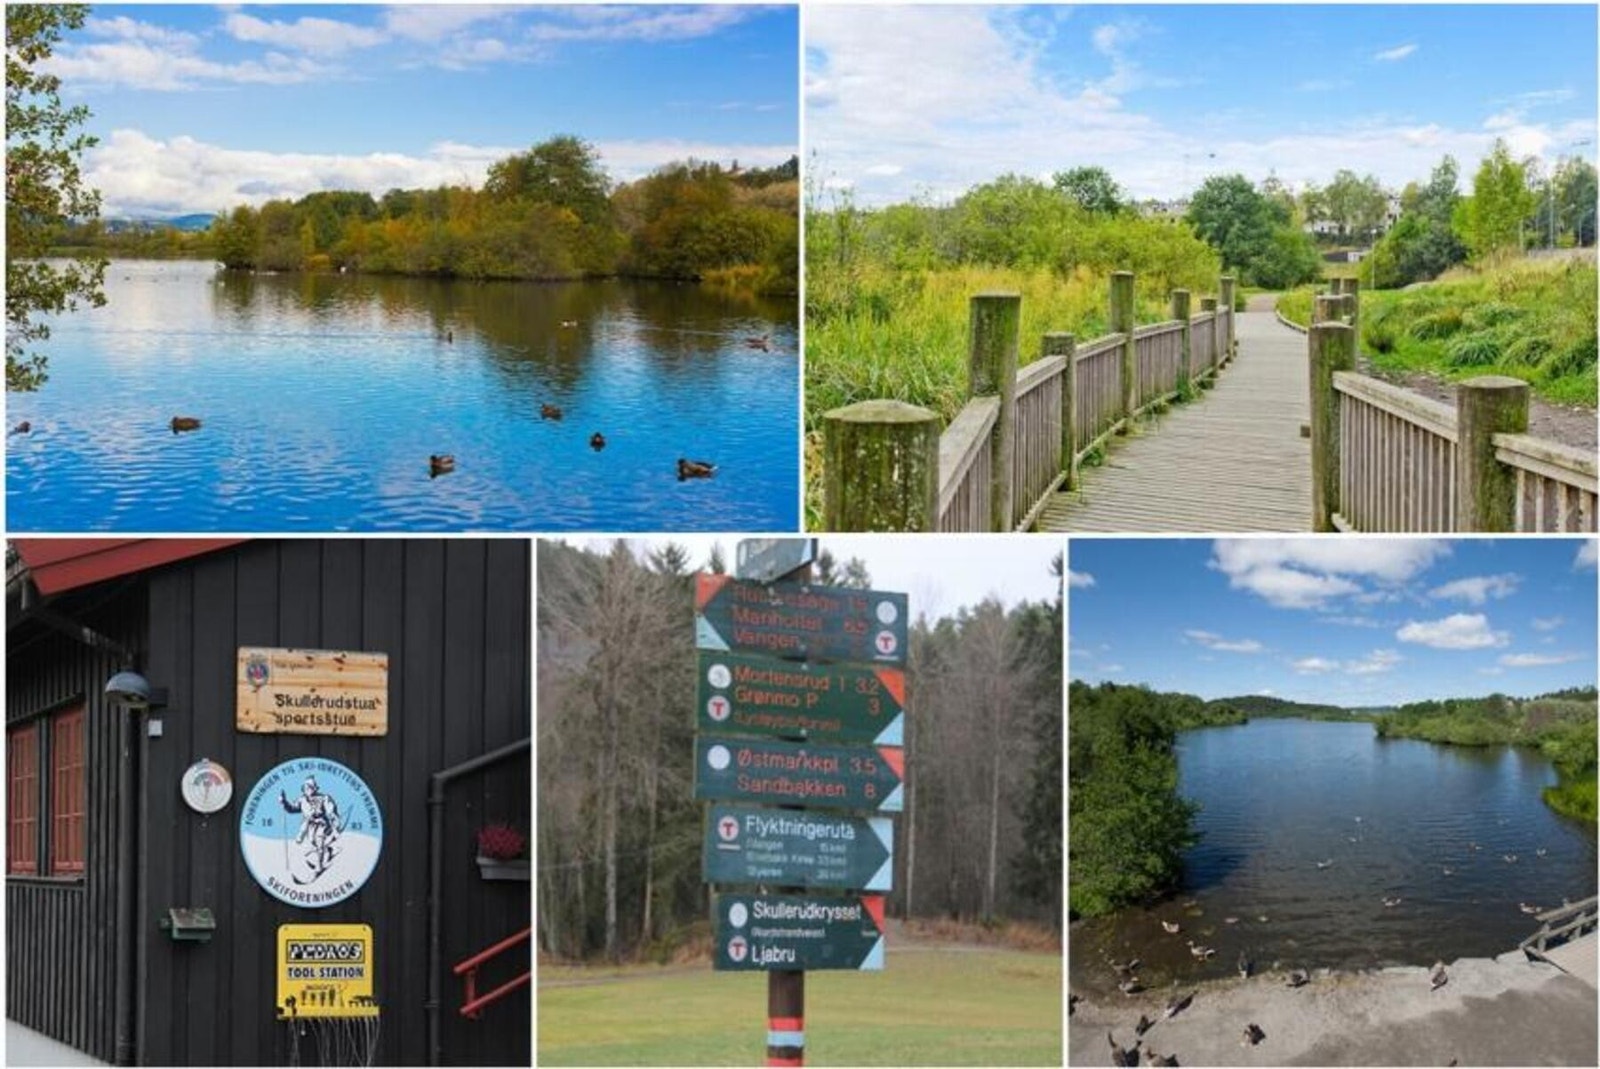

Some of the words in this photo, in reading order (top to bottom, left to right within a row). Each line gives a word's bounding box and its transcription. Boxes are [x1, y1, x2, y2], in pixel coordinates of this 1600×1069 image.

[734, 665, 830, 690] Mortensrud
[275, 694, 376, 710] Skullerudstua
[806, 692, 818, 708] P
[869, 700, 880, 715] 3
[276, 713, 356, 727] sportsstue
[737, 774, 845, 797] Sandbakken
[746, 815, 856, 840] Flyktningeruta
[267, 876, 355, 904] SKIFORENINGEN
[753, 900, 861, 922] Skullerudkrysset
[752, 945, 796, 965] Ljabru
[287, 966, 316, 978] TOOL
[319, 967, 364, 978] STATION
